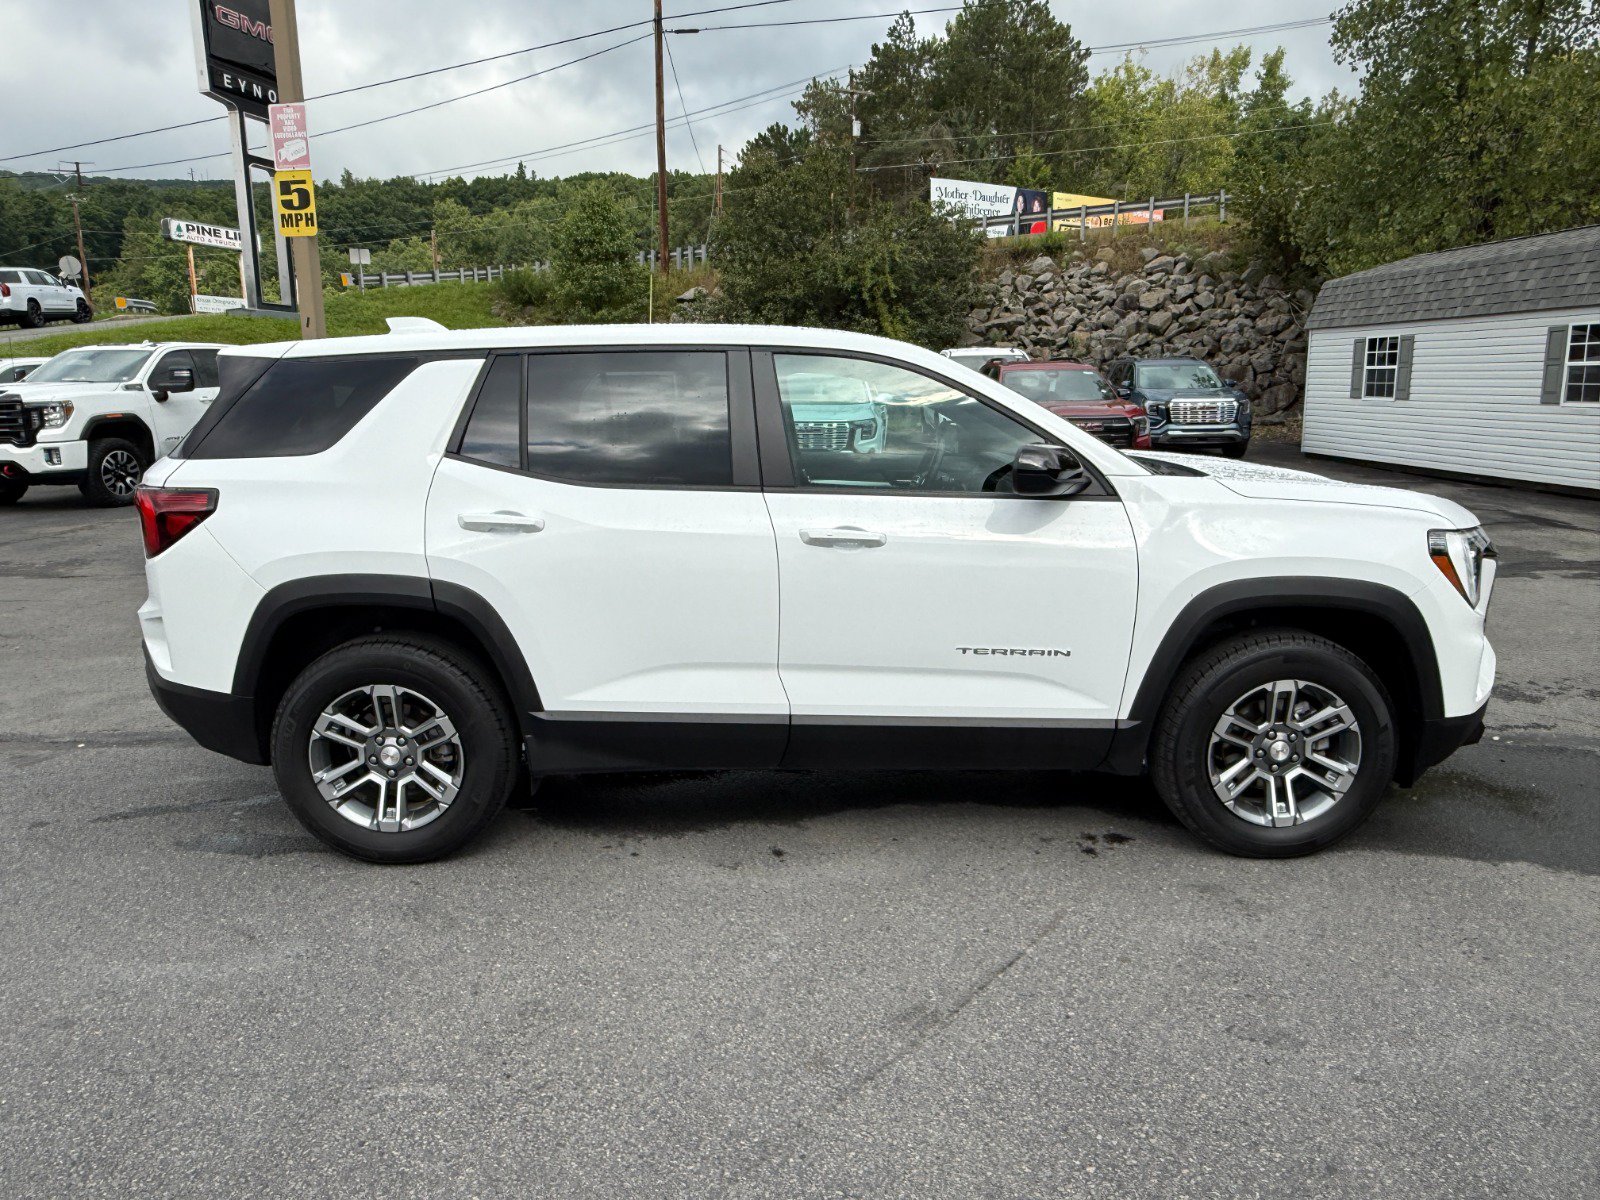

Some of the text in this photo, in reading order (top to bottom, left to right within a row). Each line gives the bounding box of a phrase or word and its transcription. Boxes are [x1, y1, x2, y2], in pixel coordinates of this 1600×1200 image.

[279, 179, 311, 211] 5
[280, 212, 315, 228] MPH
[185, 223, 222, 239] PINE
[186, 234, 205, 242] AUTO
[215, 239, 236, 247] TRUCK
[955, 647, 1071, 657] TERRAIN
